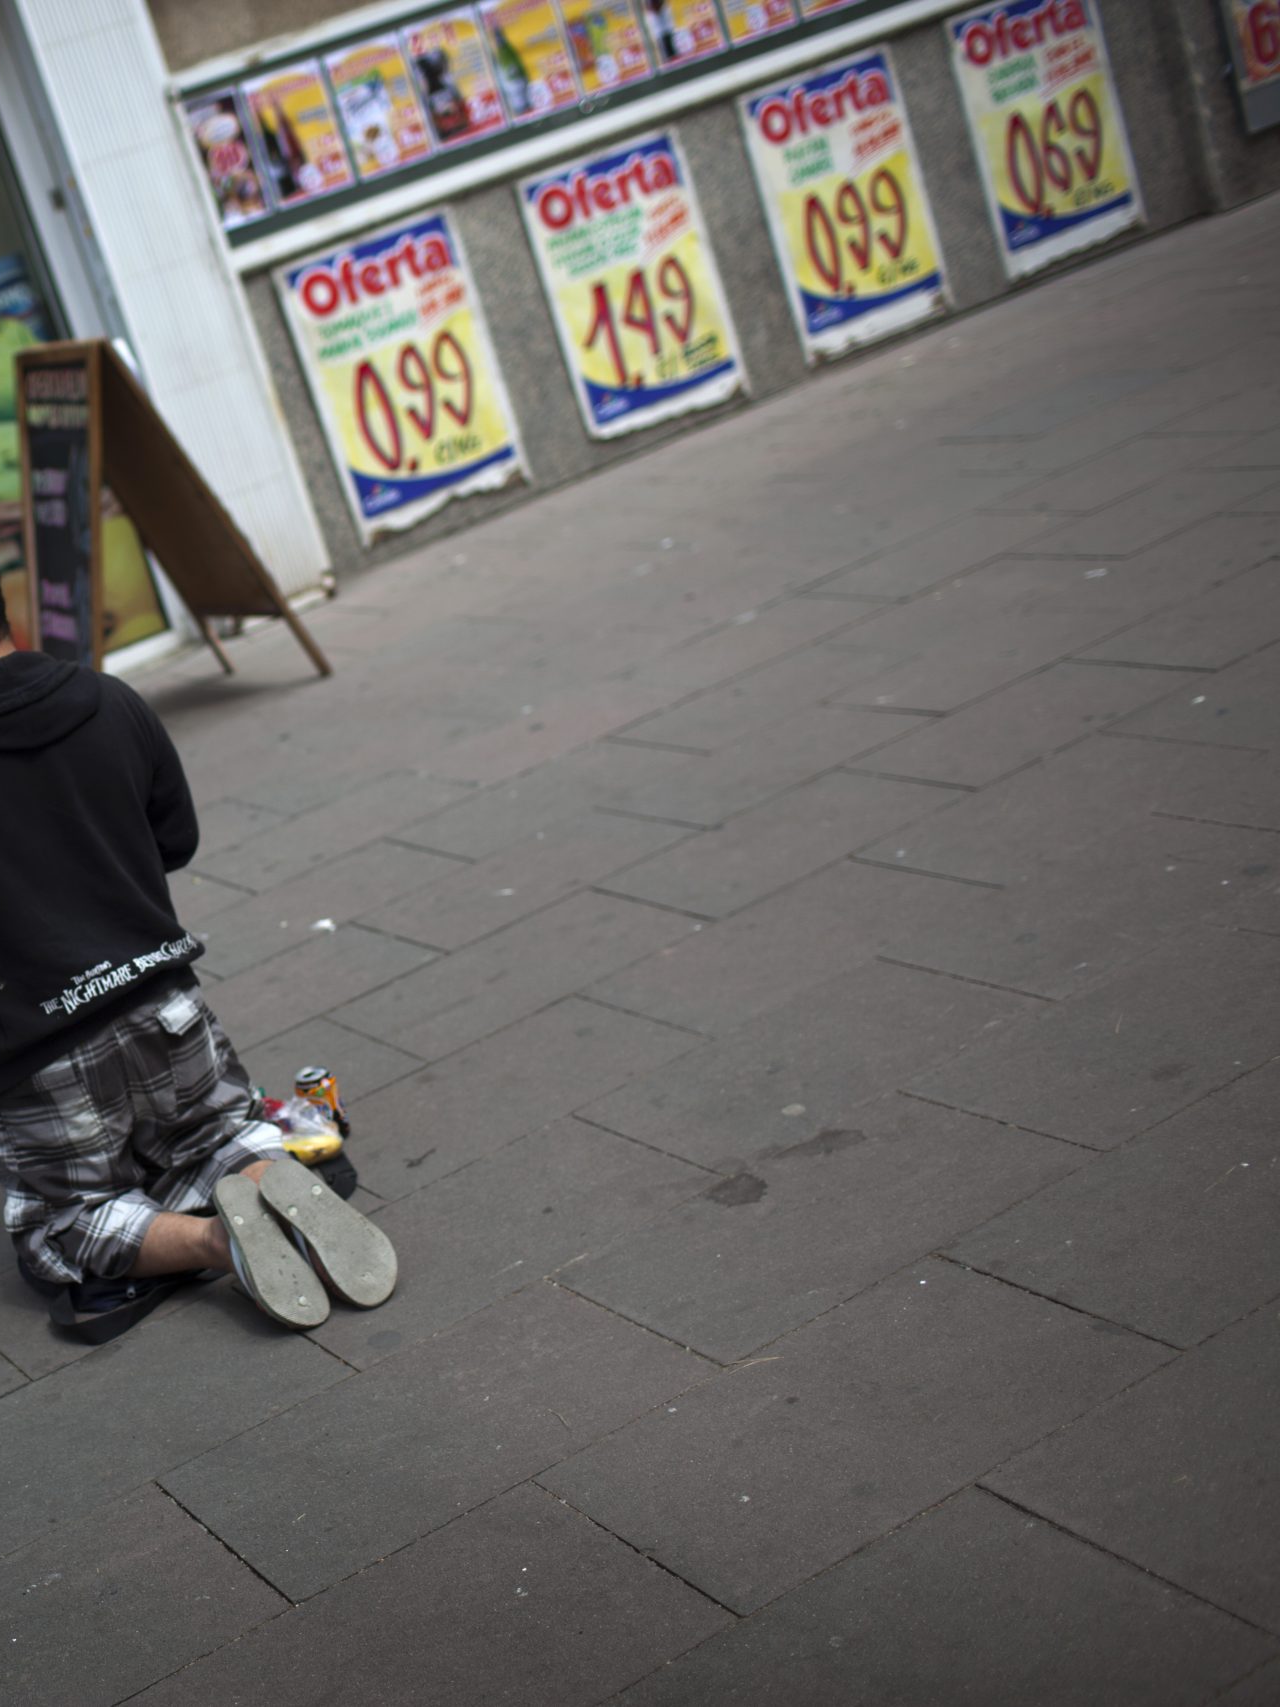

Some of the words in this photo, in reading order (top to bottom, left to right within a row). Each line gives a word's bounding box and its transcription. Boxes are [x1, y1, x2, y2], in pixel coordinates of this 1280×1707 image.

[965, 0, 1088, 66] Oferta
[759, 72, 892, 145] Oferta
[538, 155, 679, 231] Oferta
[300, 236, 453, 317] Oferta
[40, 997, 63, 1015] THE
[61, 963, 138, 1015] NIGHTMARE
[158, 933, 198, 962] CHRIS
